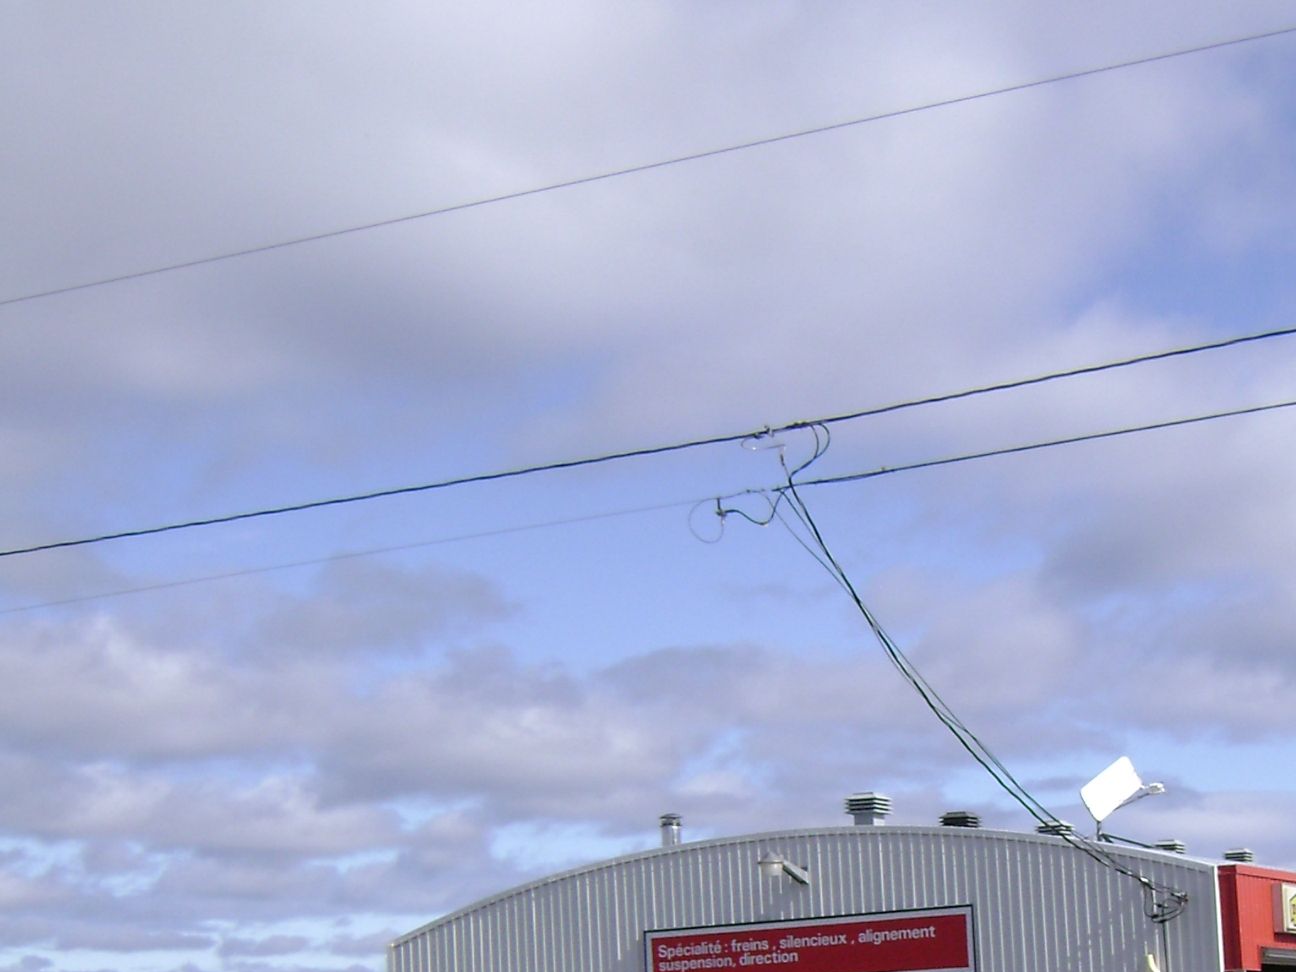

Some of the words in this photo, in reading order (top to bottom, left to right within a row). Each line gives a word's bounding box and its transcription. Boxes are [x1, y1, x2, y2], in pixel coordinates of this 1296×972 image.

[731, 939, 769, 953] freins
[779, 933, 847, 949] silencieux
[858, 926, 936, 945] alignement
[658, 956, 736, 972] suspension,
[739, 950, 799, 967] direction
